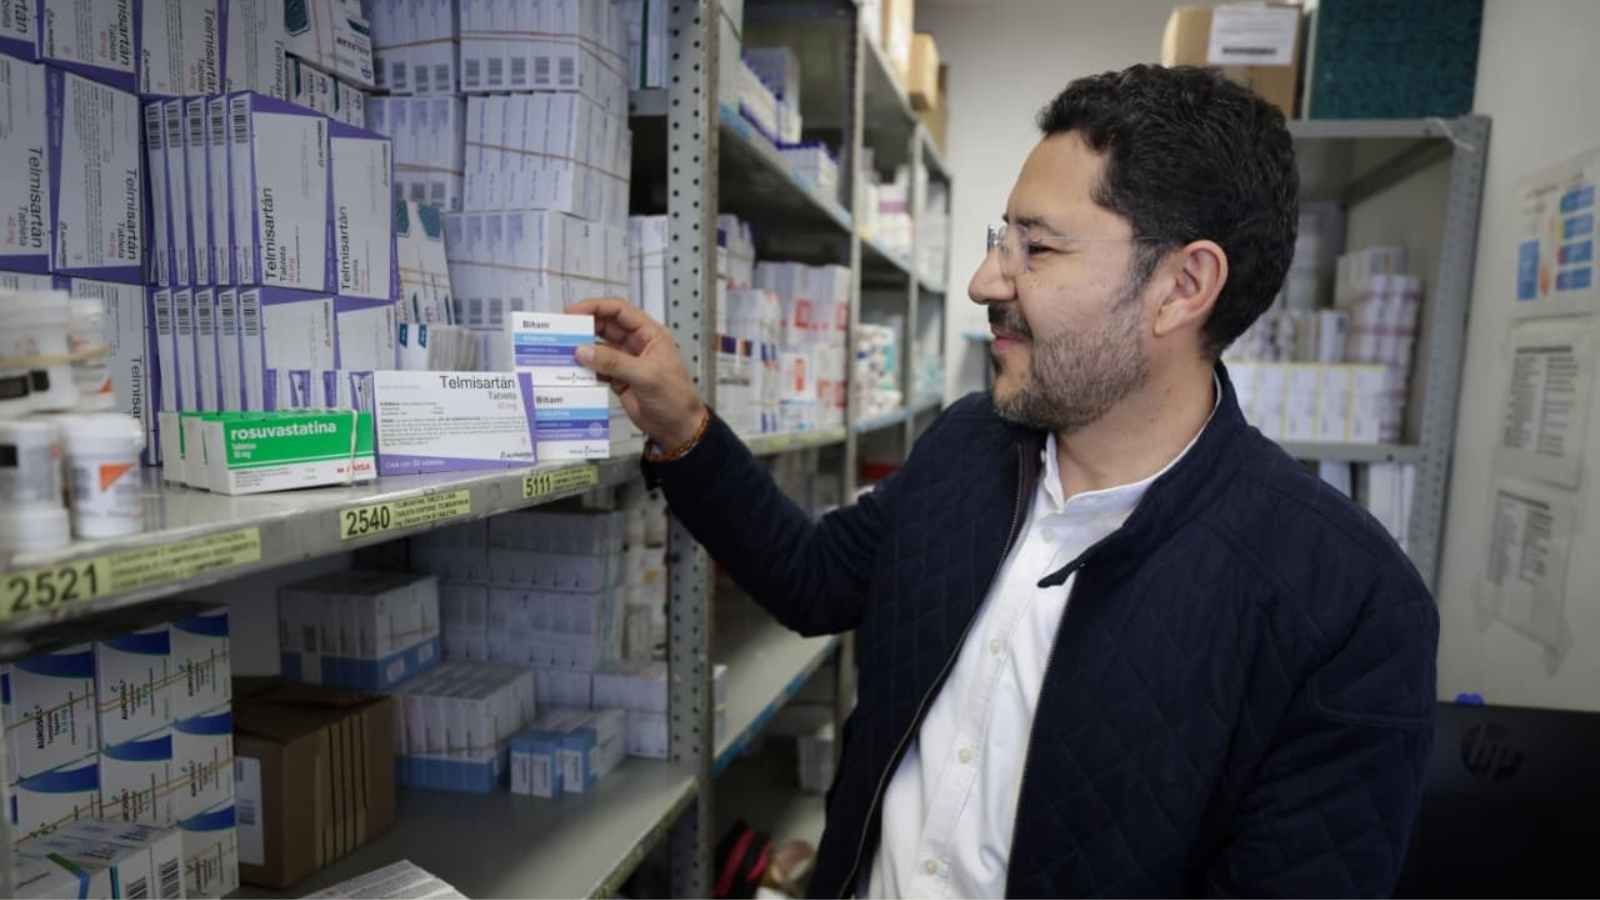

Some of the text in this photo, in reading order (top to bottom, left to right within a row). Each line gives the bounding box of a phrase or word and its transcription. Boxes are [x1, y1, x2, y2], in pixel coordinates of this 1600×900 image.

[29, 146, 43, 248] Telmisartán
[19, 206, 28, 247] Tableta
[125, 167, 137, 260] Telmisartán
[261, 187, 277, 281] Telmisartán
[338, 206, 350, 291] Telmisartán
[522, 320, 549, 329] Bitam
[439, 375, 515, 389] Telmisartán
[487, 391, 517, 400] Tableta
[536, 396, 563, 404] Bitam
[230, 421, 337, 440] rosuvastatina
[526, 475, 550, 497] 5111
[346, 506, 390, 536] 2540
[7, 561, 98, 613] 2521
